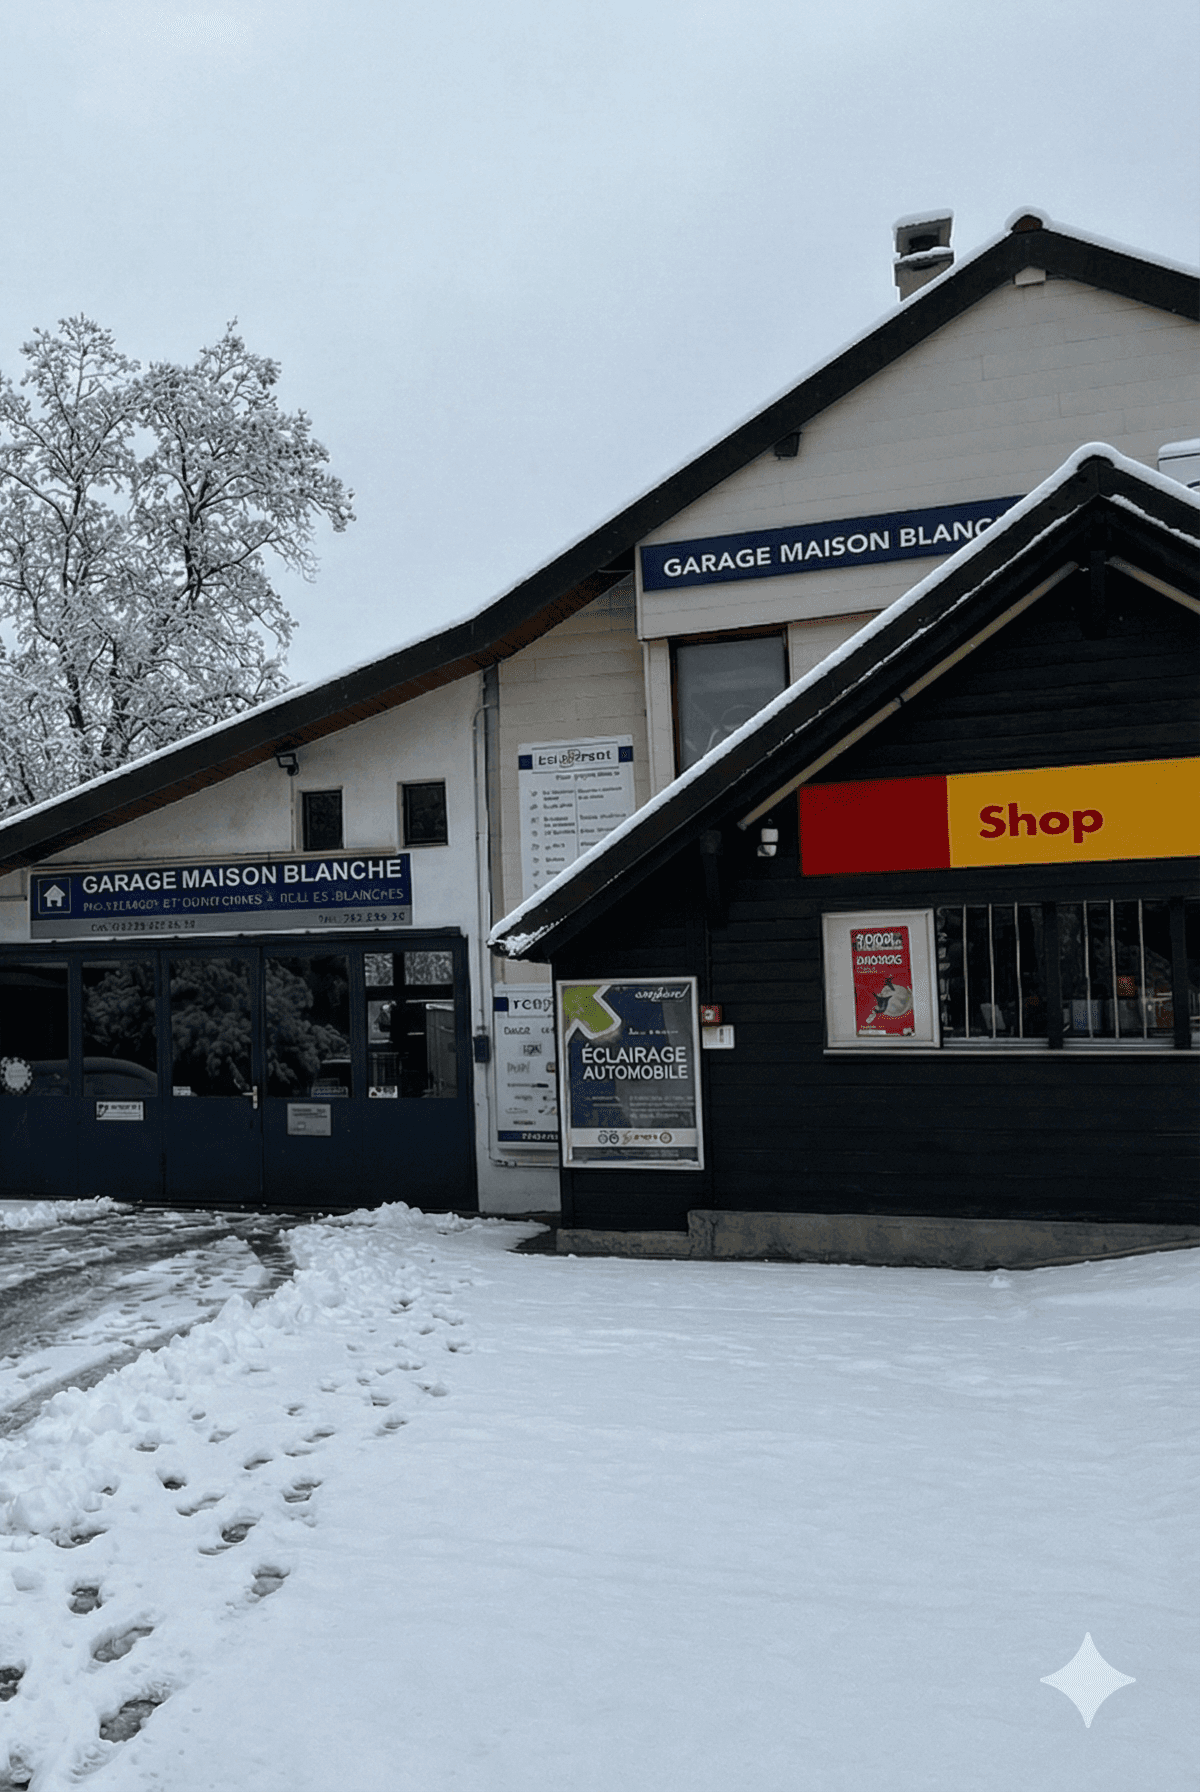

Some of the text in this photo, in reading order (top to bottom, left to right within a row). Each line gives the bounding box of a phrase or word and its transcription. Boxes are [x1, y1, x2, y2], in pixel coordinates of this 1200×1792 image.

[663, 516, 1002, 578] GARAGE MAISON BLANC
[979, 802, 1104, 844] Shop
[82, 859, 402, 895] GARAGE MAISON BLANCHE
[581, 1044, 687, 1064] ÉCLAIRAGE
[583, 1064, 689, 1080] AUTOMOBILE
